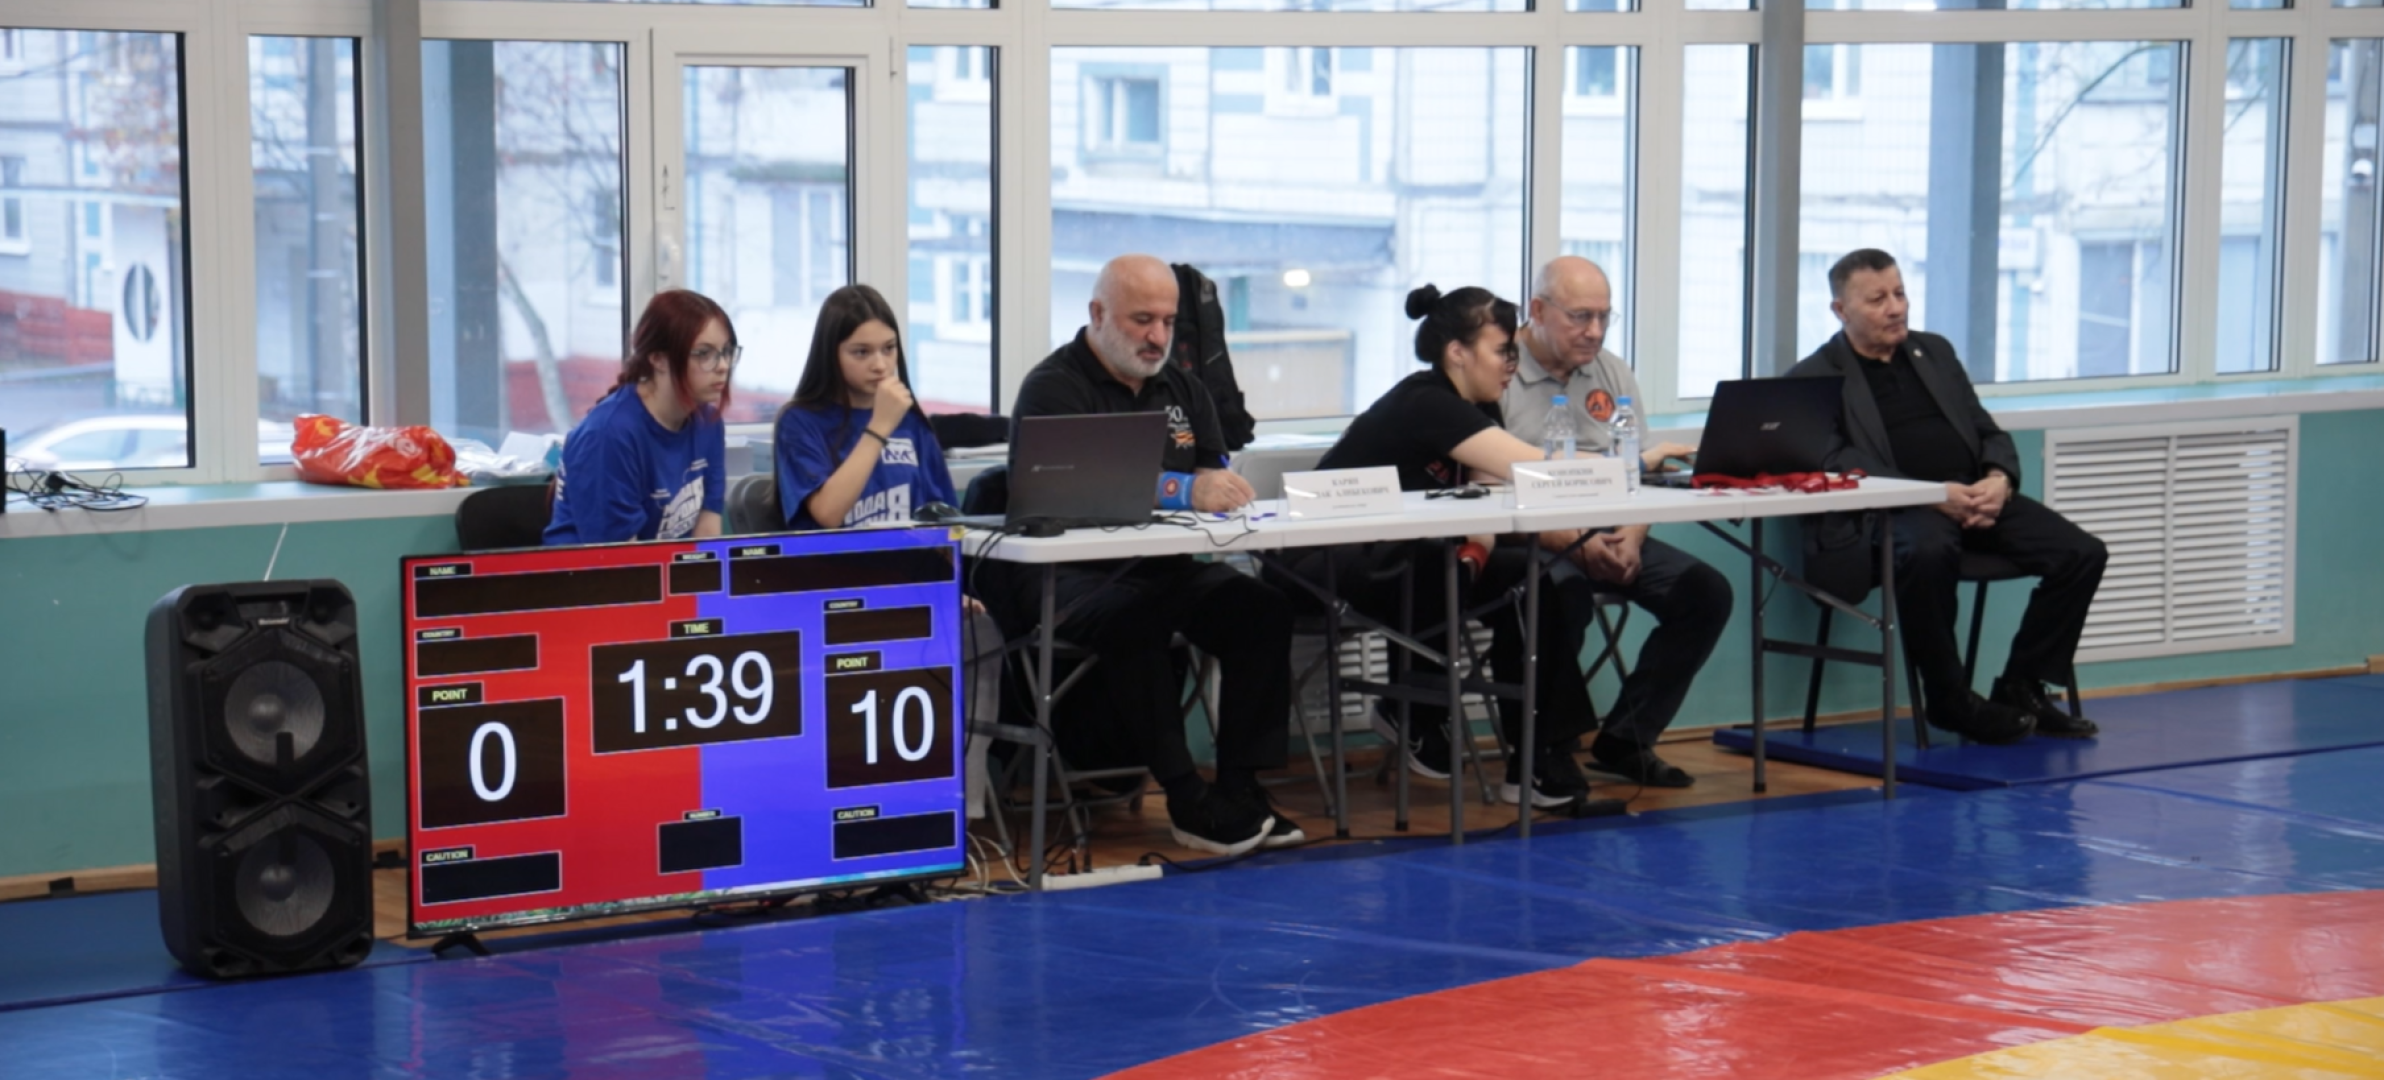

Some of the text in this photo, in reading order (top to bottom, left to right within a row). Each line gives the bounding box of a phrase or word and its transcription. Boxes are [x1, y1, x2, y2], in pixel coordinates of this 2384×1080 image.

[742, 547, 767, 556] NAME
[429, 566, 456, 576] NAME
[683, 622, 710, 634] TIME
[836, 656, 868, 669] POINT
[432, 688, 468, 702] POINT
[618, 651, 774, 733] 1:39
[851, 686, 935, 764] 10
[469, 721, 517, 802] 0
[837, 808, 875, 820] CAUTION
[426, 850, 468, 862] CAUTION
